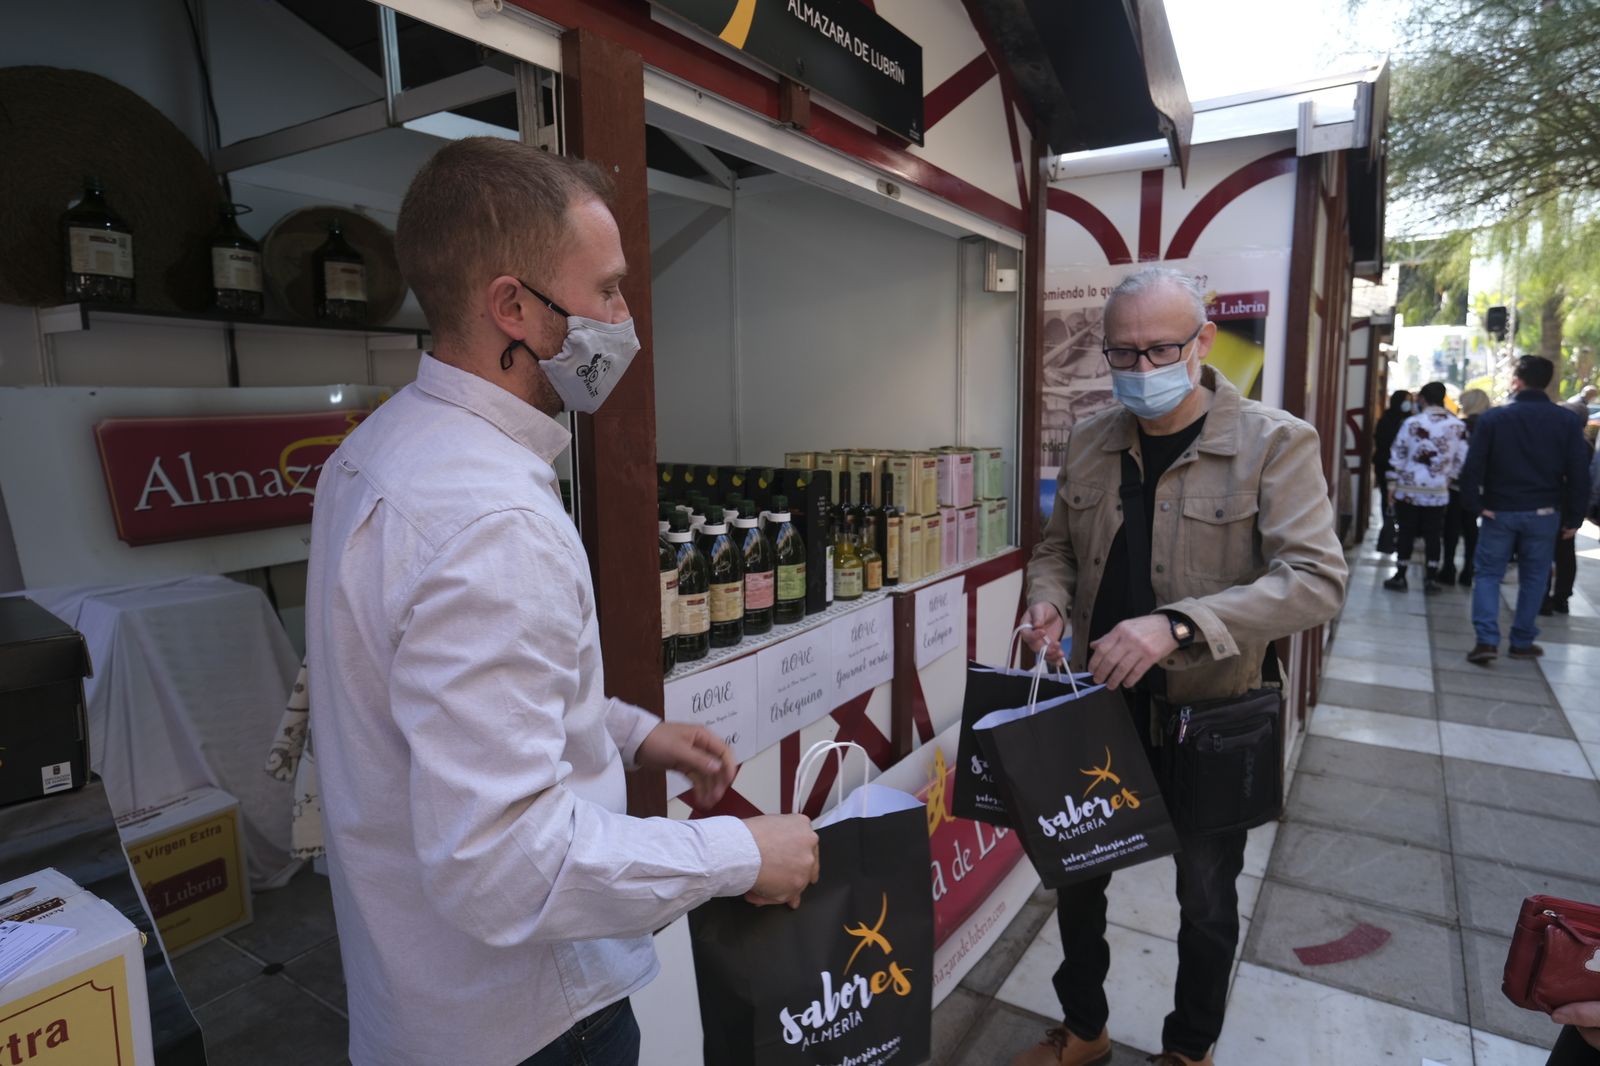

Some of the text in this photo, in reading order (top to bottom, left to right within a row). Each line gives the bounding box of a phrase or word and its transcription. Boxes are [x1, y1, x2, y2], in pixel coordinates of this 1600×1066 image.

[788, 0, 852, 51] ALMAZARA
[854, 37, 869, 63] DE
[1088, 285, 1097, 297] lo
[1037, 787, 1141, 837] sabores
[1057, 817, 1107, 842] ALMERÍA
[145, 838, 186, 860] Virgen
[189, 824, 222, 844] Extra
[951, 840, 974, 882] de
[779, 961, 913, 1044] sabores
[801, 1010, 864, 1052] ALMERÍA
